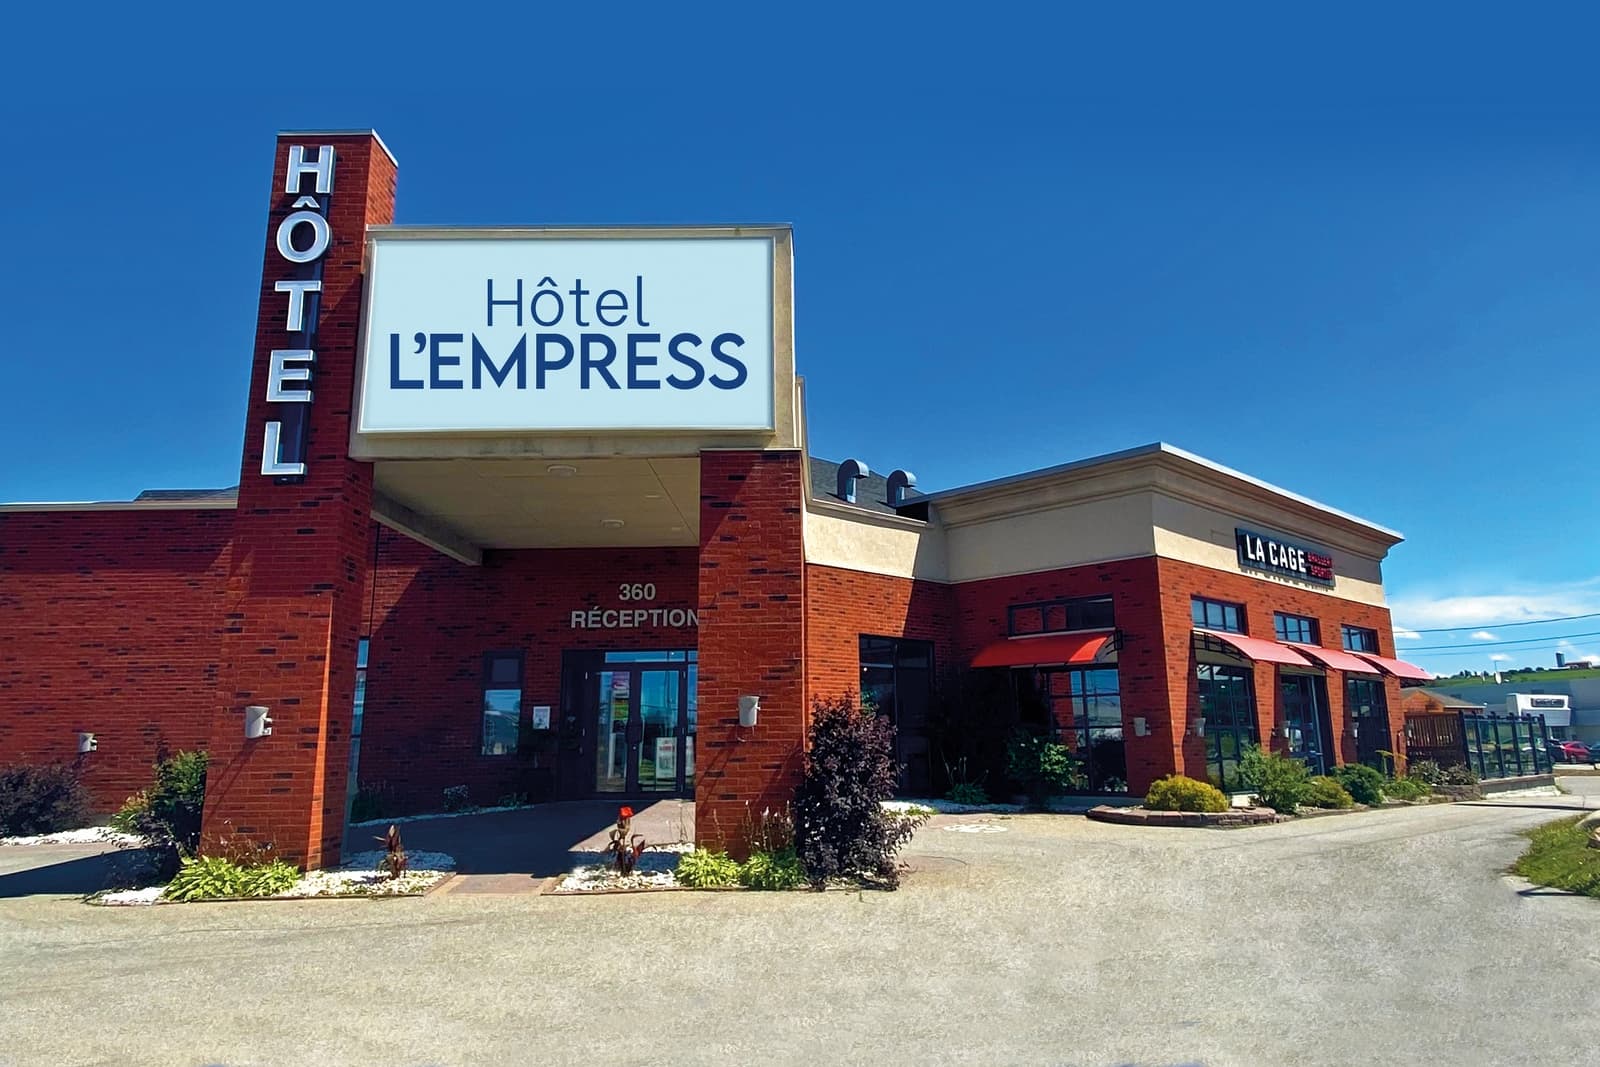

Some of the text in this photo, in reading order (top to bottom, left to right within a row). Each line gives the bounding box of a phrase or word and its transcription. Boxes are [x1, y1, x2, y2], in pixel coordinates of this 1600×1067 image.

[261, 145, 335, 476] HÔTEL
[486, 276, 650, 327] Hôtel
[389, 332, 748, 390] L’EMPRESS
[1246, 534, 1266, 562] LA
[1268, 541, 1307, 573] CAGE
[618, 583, 656, 600] 360
[570, 606, 699, 628] RÉCEPTION
